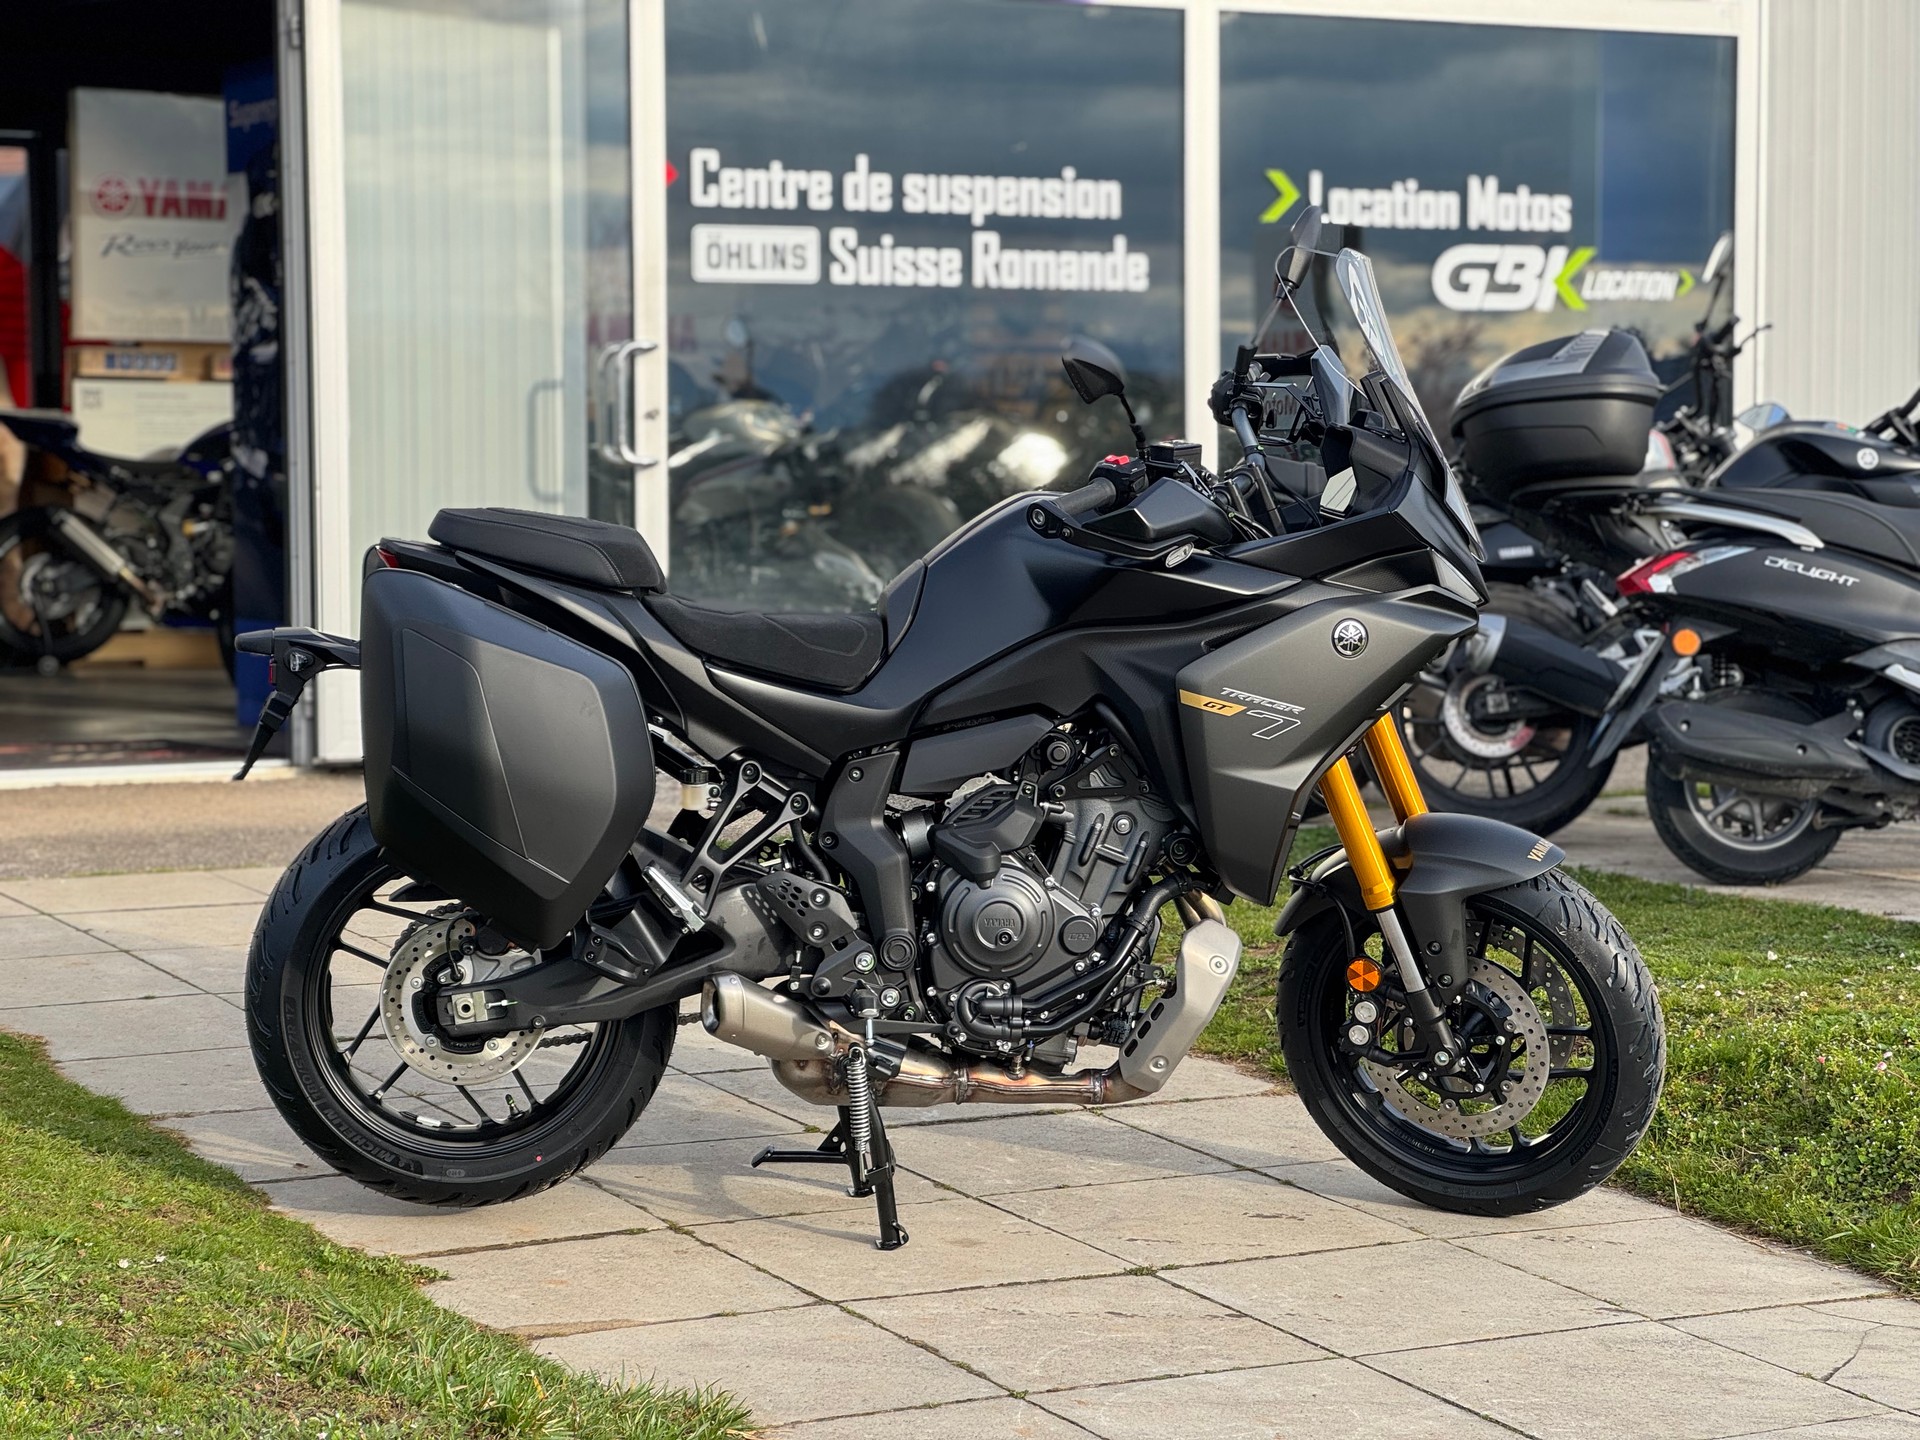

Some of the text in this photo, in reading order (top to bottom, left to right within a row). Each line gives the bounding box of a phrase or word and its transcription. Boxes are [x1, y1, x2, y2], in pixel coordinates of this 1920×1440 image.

[690, 147, 1122, 226] Centre de suspension
[1308, 169, 1572, 233] Location Motos
[706, 231, 808, 270] ÖHLINS
[829, 226, 1149, 292] Suisse Romande
[1432, 243, 1597, 312] GBK
[1581, 270, 1680, 301] LOCATION
[1202, 701, 1234, 712] GT
[1220, 687, 1306, 714] TRACER
[1246, 709, 1301, 740] 7
[984, 917, 1016, 928] YAMAHA
[321, 1106, 396, 1163] MICHELIN
